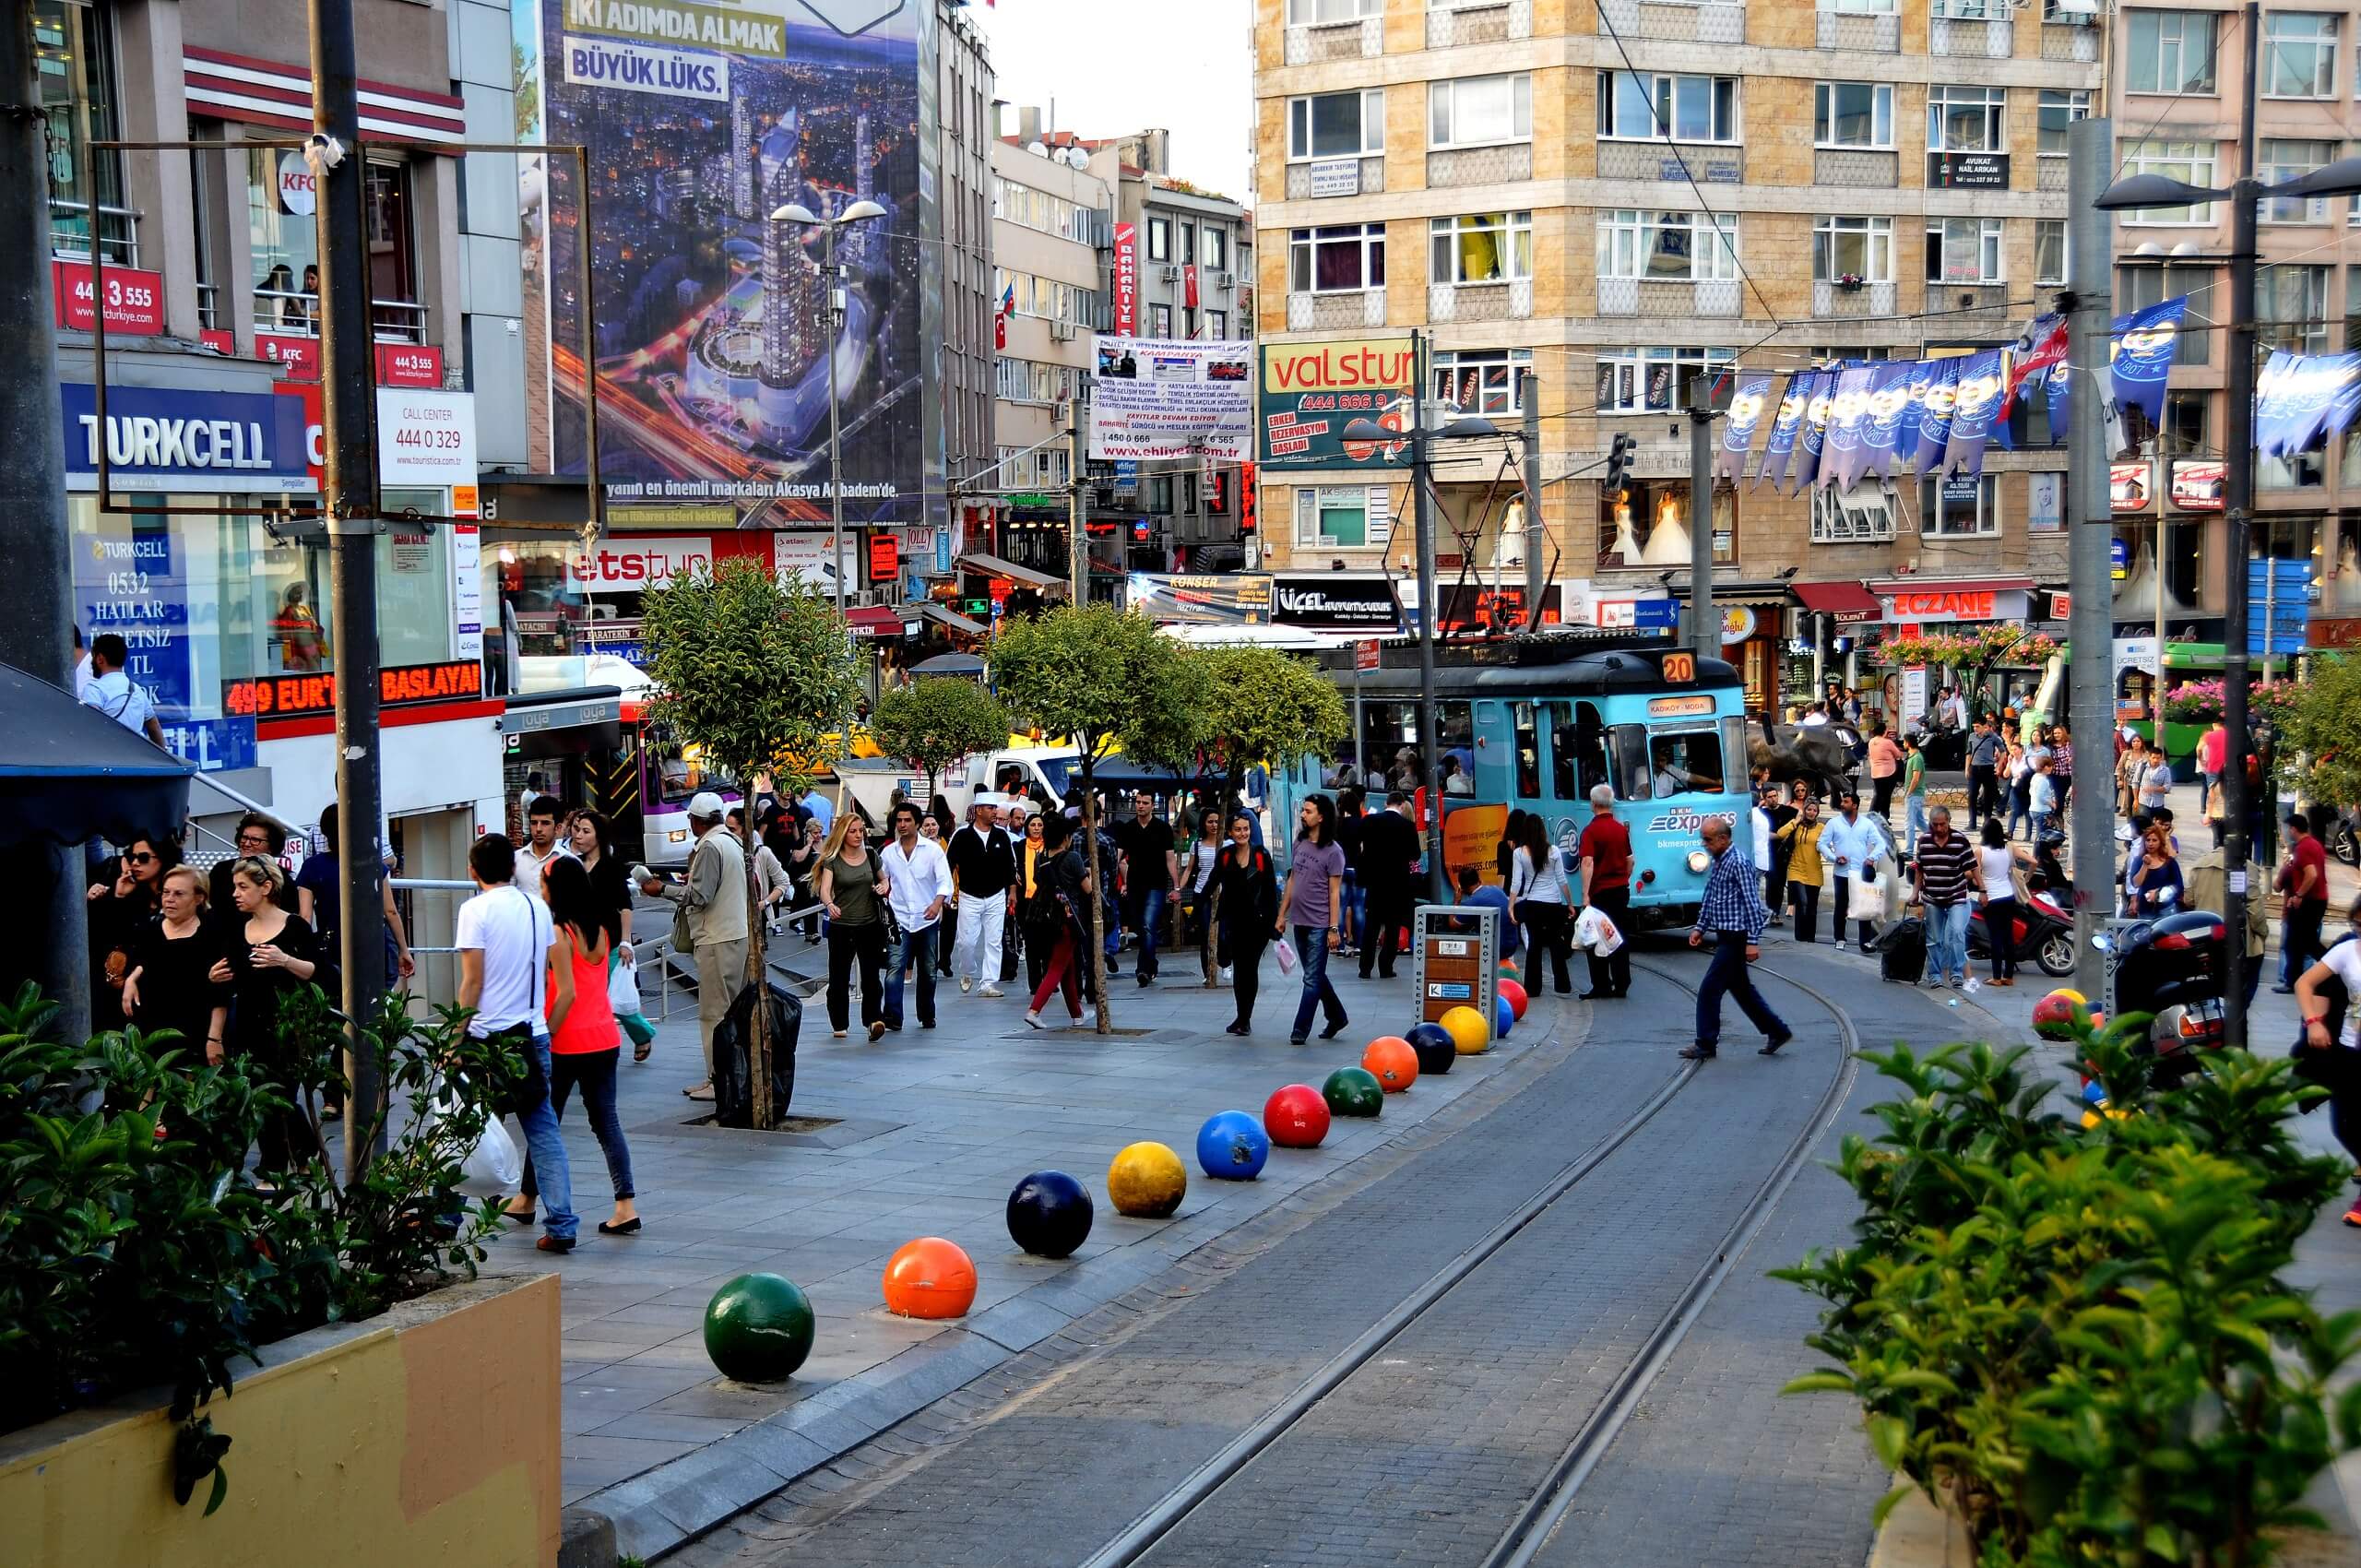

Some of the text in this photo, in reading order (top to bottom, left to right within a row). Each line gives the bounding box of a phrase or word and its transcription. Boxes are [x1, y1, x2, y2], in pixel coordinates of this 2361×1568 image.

[606, 2, 699, 42] ADIMDA
[701, 12, 781, 53] ALMAK
[572, 46, 722, 94] BÜYÜK LÜKS.
[282, 172, 317, 192] KFC
[108, 280, 152, 307] 3 555
[282, 349, 303, 361] KFC
[395, 354, 433, 370] 444 3 555
[1274, 346, 1415, 388] valstur
[1461, 372, 1478, 407] SABAH
[1303, 393, 1387, 410] 444 666 9
[403, 407, 453, 422] CALL CENTER
[1268, 413, 1295, 427] ERKEN
[79, 414, 273, 469] TURKCELL
[396, 428, 461, 449] 444 0 329
[1270, 421, 1328, 441] REZERVASYON
[646, 481, 662, 496] en
[665, 480, 709, 496] önemli
[711, 481, 774, 498] markaları
[775, 481, 820, 499] Akasya
[104, 540, 167, 559] TURKCELL
[906, 528, 934, 552] JOLLY
[572, 549, 706, 583] etstur
[108, 571, 149, 595] 0532
[1169, 576, 1218, 588] KONSER
[96, 600, 165, 620] HATLAR
[1893, 591, 1996, 616] ECZANE
[130, 655, 154, 675] TL
[1663, 657, 1691, 681] 20
[227, 681, 273, 715] 499
